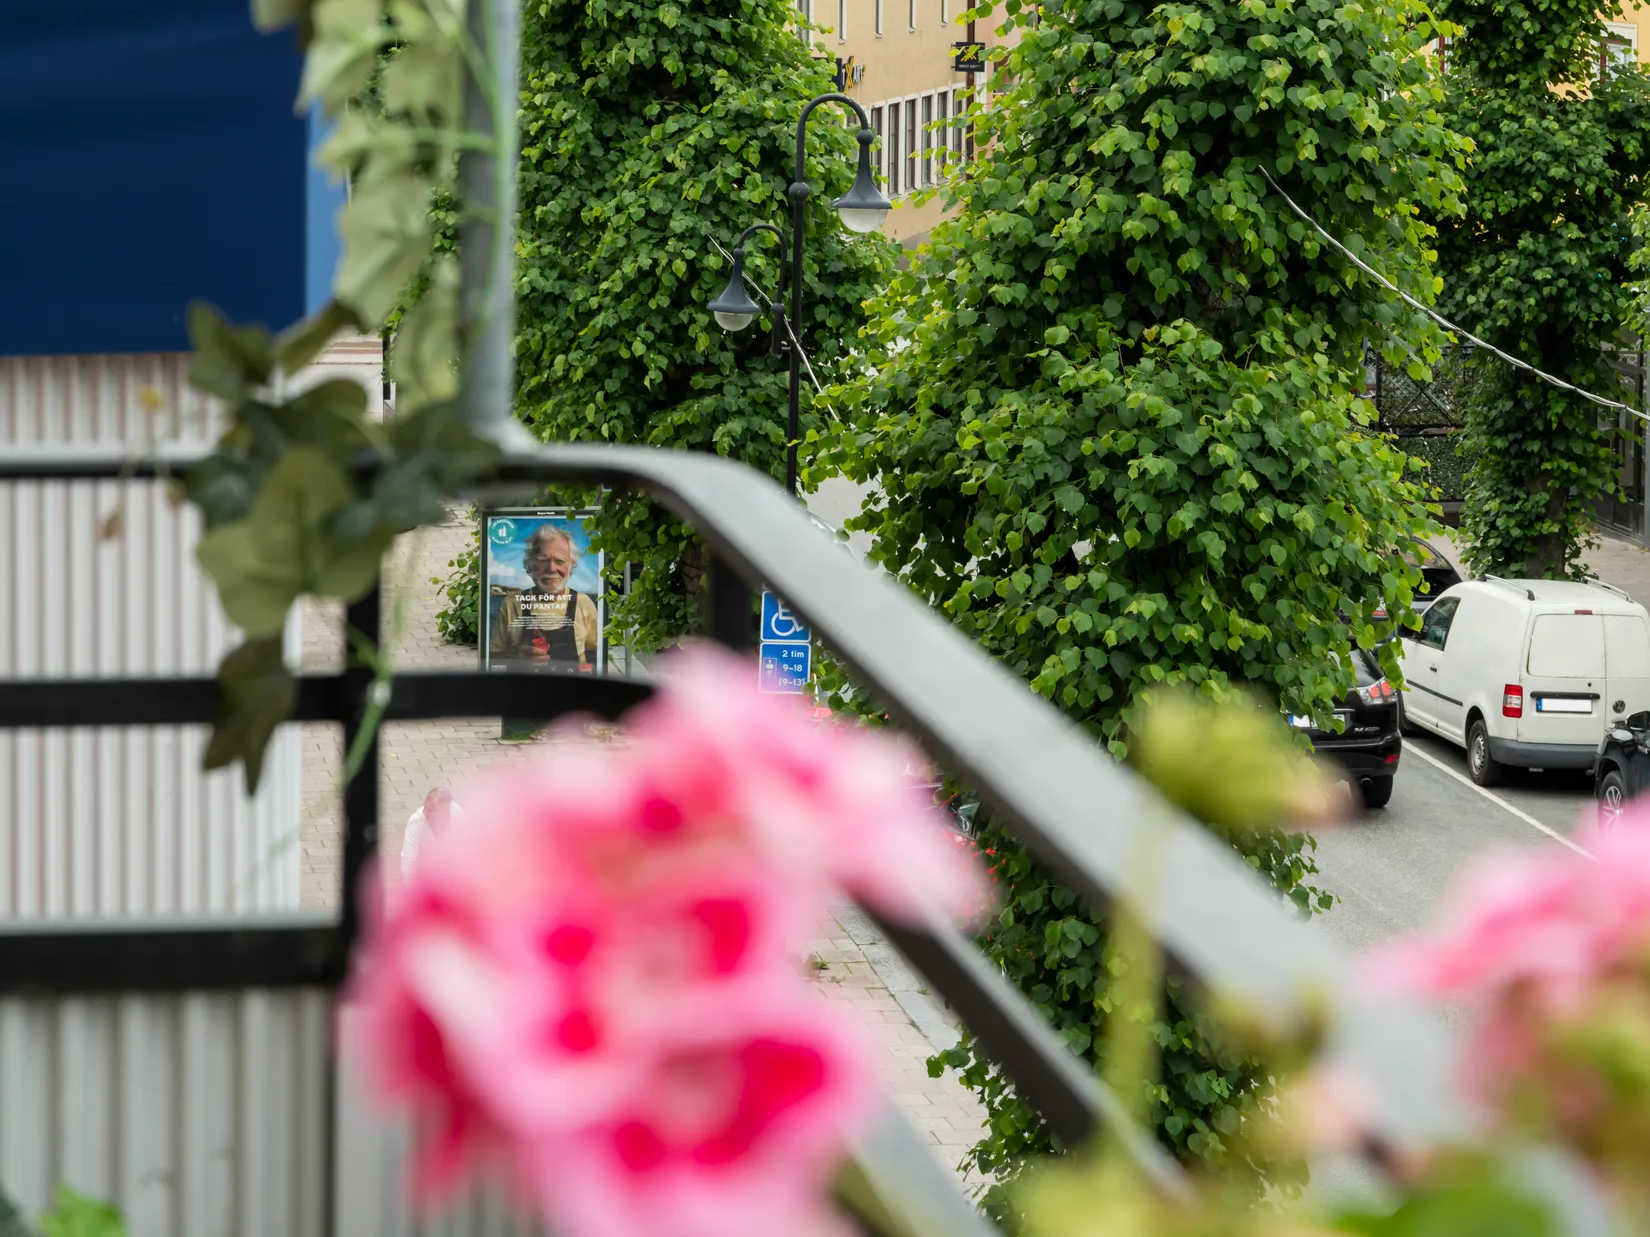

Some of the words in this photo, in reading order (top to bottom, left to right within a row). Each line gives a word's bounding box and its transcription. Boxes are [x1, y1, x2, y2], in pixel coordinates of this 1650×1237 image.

[539, 593, 555, 602] FÖR
[782, 649, 789, 658] 2
[791, 649, 805, 658] tim
[782, 663, 803, 672] 9-18
